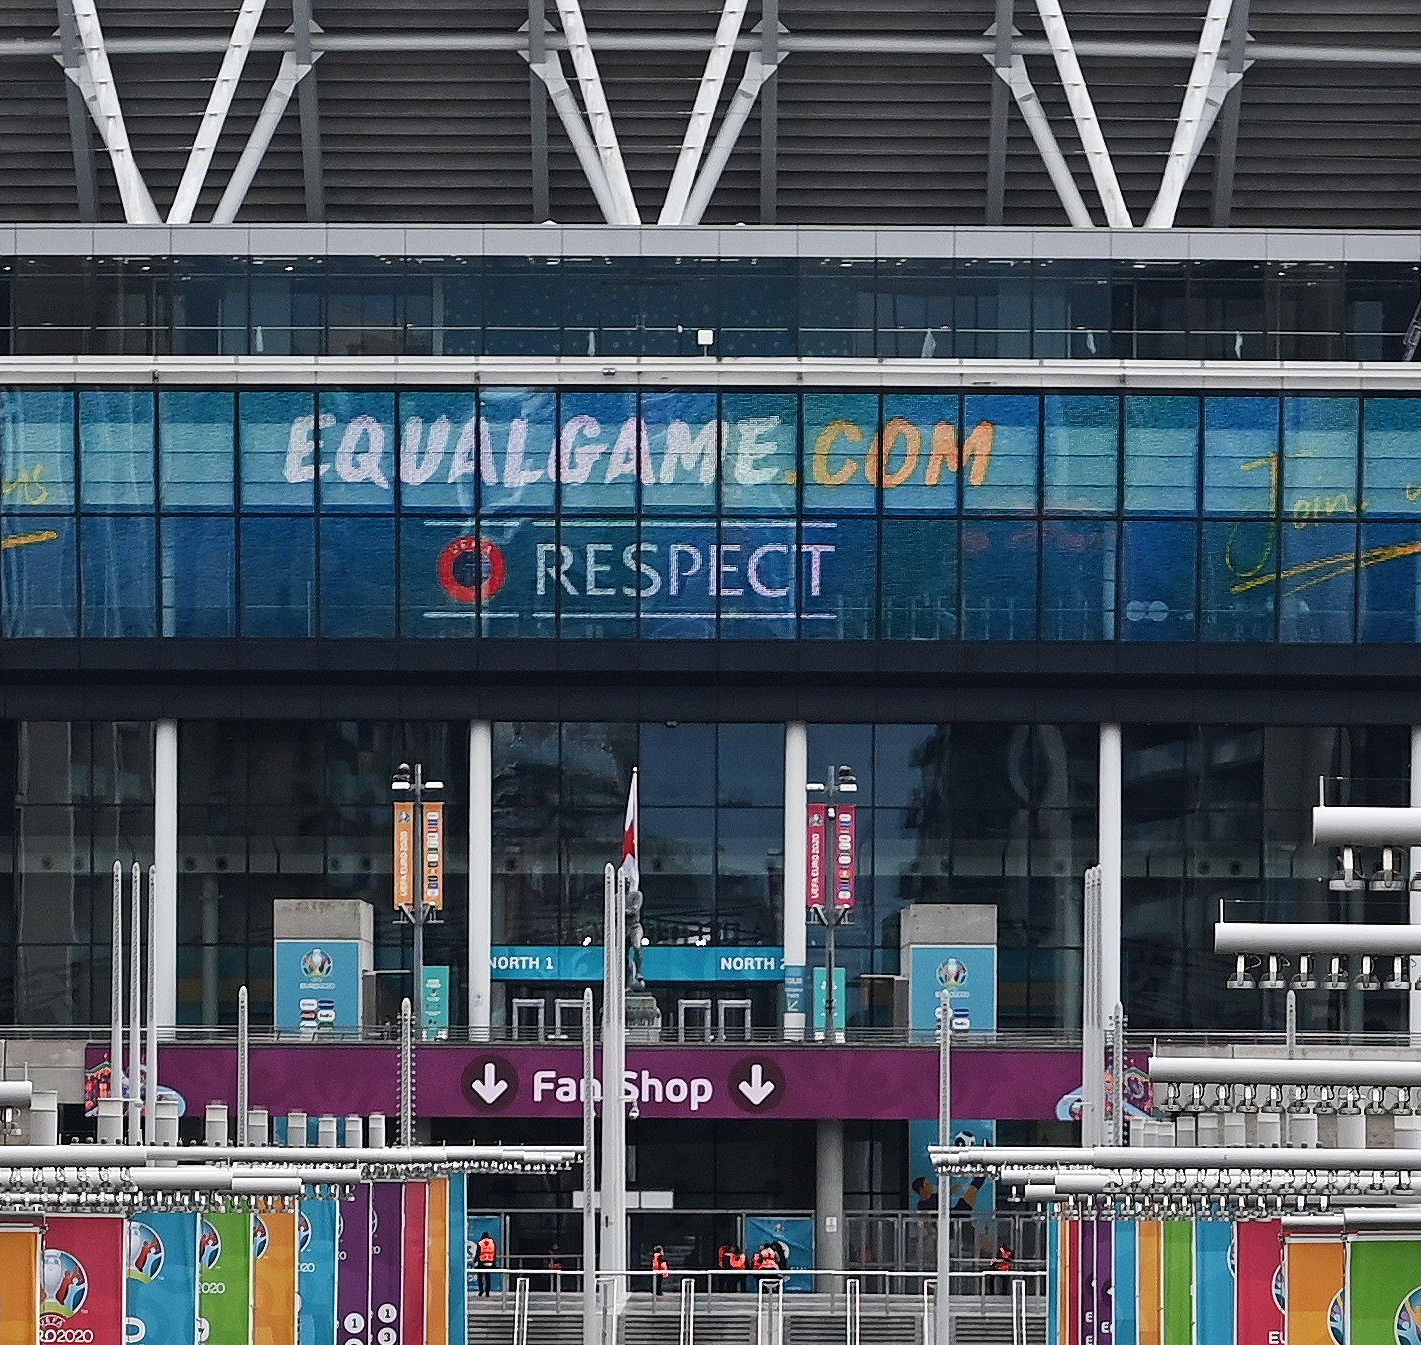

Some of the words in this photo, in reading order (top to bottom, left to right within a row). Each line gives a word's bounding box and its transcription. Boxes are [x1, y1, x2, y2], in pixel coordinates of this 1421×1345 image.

[282, 415, 995, 489] EQUALGAME.COM
[535, 543, 836, 598] RESPECT
[489, 957, 538, 970] NORTH
[545, 957, 554, 970] 1
[720, 957, 775, 971] NORTH
[533, 1070, 602, 1102] Fan
[622, 1070, 713, 1110] Shop
[384, 1309, 391, 1318] 1
[351, 1319, 358, 1328] 1
[384, 1332, 391, 1342] 3
